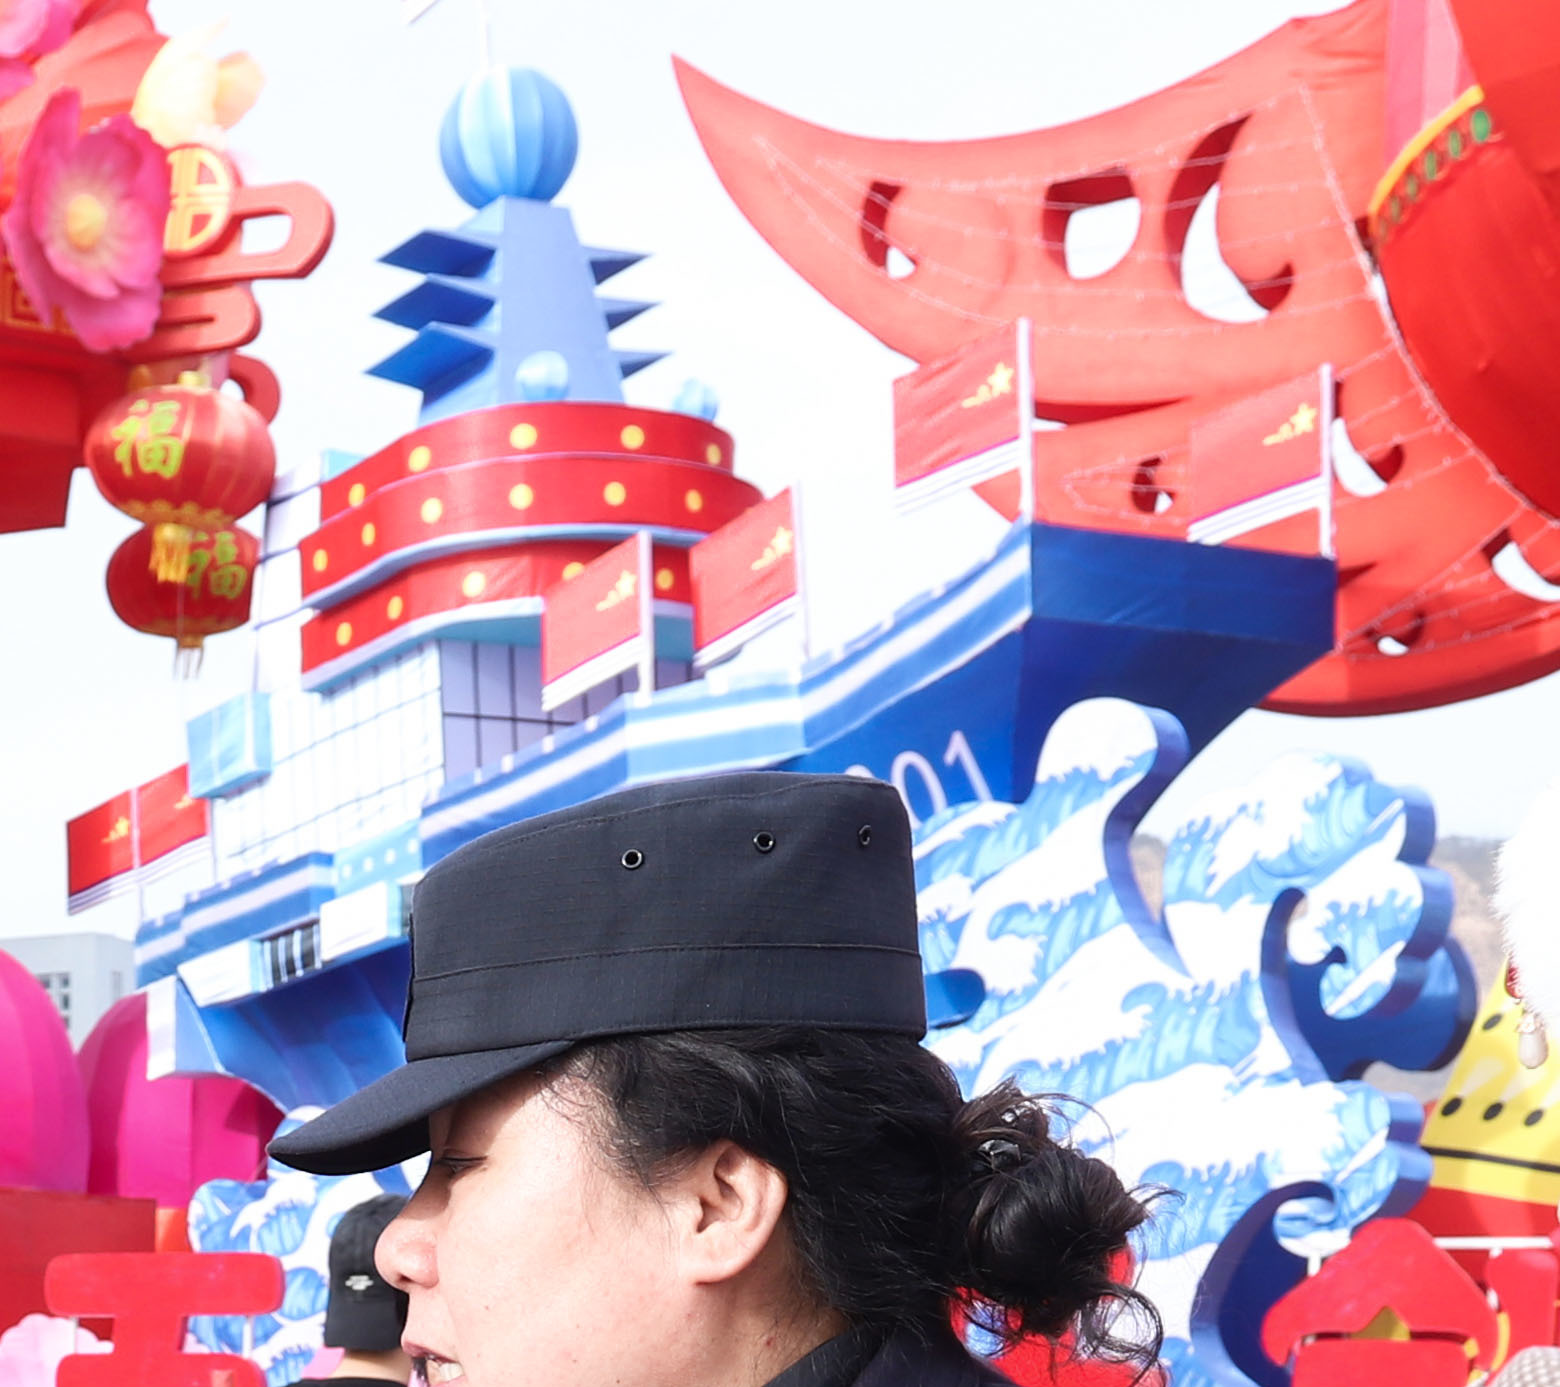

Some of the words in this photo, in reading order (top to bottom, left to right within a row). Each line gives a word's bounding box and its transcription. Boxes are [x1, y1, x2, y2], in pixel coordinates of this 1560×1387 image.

[112, 399, 185, 478] 福
[186, 531, 247, 598] 福
[844, 730, 994, 829] 01
